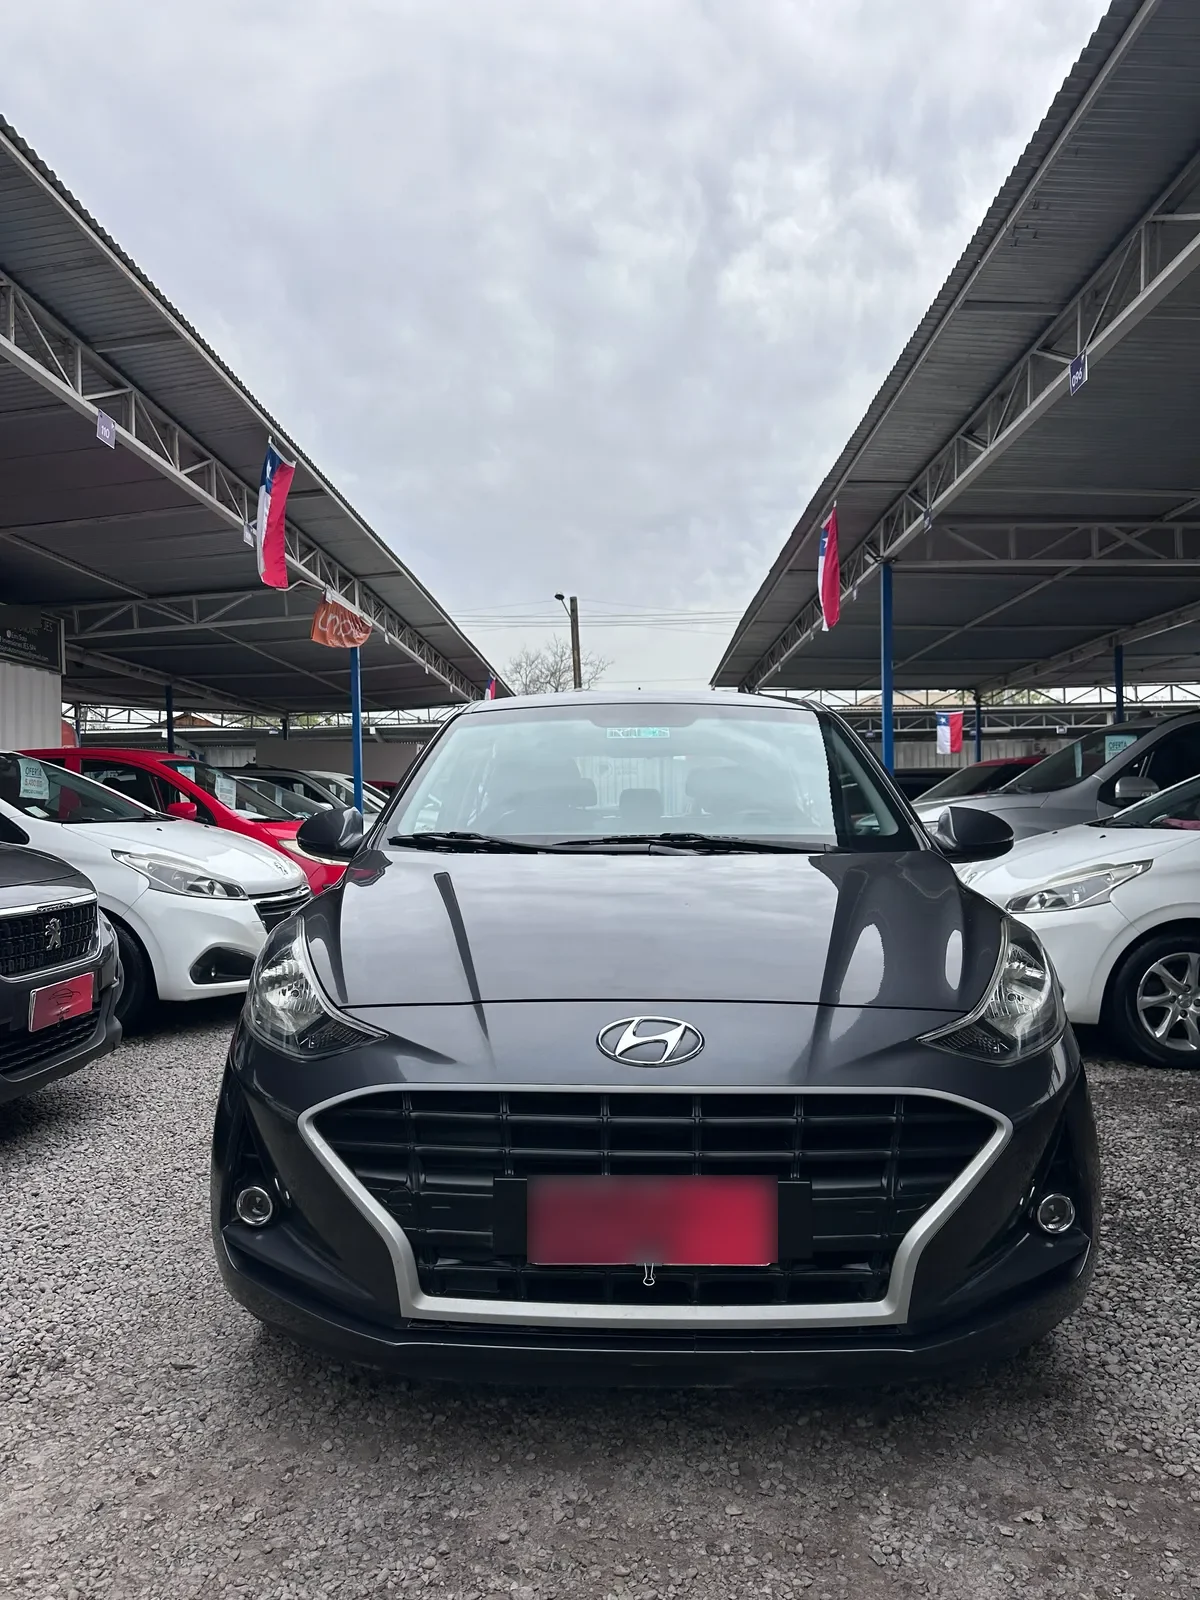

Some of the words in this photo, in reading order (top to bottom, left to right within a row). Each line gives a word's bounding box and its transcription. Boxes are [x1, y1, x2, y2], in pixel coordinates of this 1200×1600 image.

[1071, 367, 1082, 387] 096
[101, 425, 110, 439] 110
[1108, 741, 1127, 750] OFERTA
